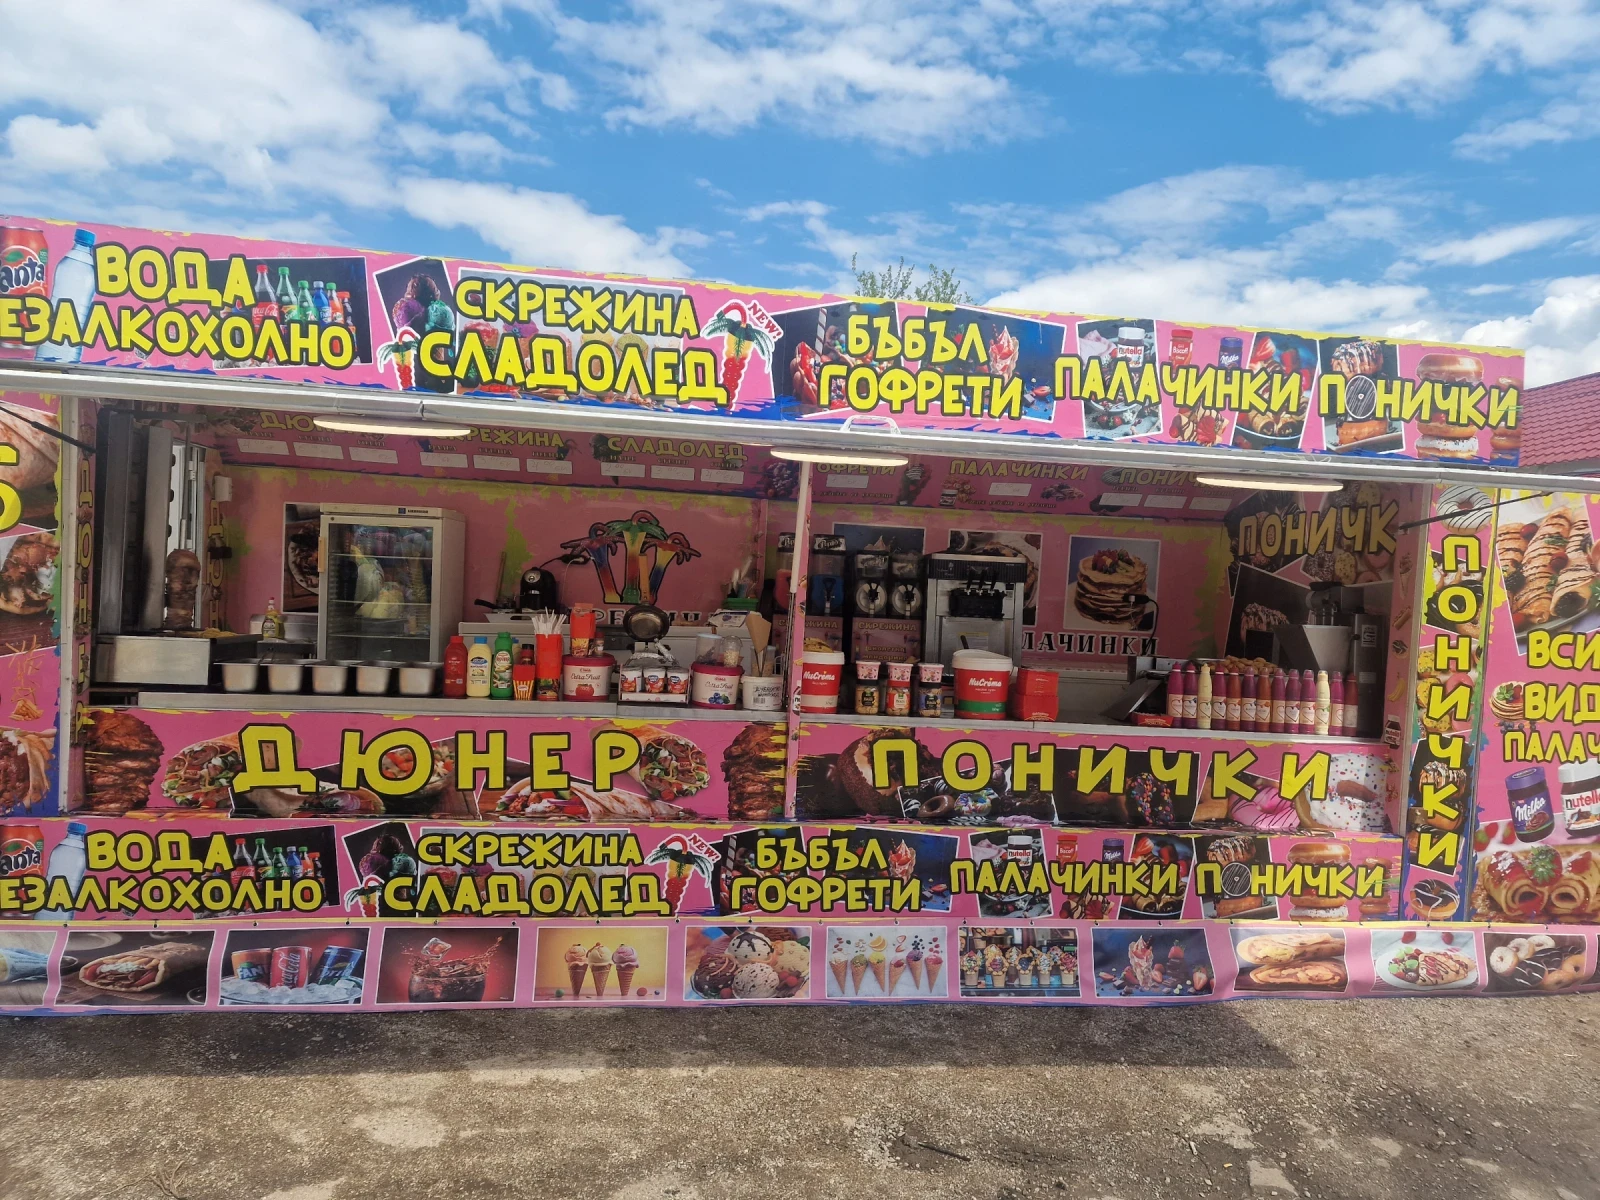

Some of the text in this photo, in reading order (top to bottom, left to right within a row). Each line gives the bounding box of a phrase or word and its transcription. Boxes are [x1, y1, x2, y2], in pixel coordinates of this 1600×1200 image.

[95, 242, 256, 308] ВОДА
[454, 276, 700, 338] СКРЕЖИНА
[748, 302, 782, 339] NEW!
[847, 312, 989, 364] БЪБЪЛ
[418, 330, 731, 407] СЛАДОЛЕД
[1053, 354, 1302, 415] ПАЛАЧИНКИ
[818, 363, 1023, 419] ГОФРЕТИ
[606, 435, 748, 461] СЛАДОЛЕД
[949, 459, 1090, 481] ПАЛАЧИНКИ
[1416, 534, 1482, 870] ПОНИЧКИ
[231, 723, 642, 797] ДЮНЕР
[871, 737, 1331, 801] ПОНИЧКИ
[1514, 797, 1547, 822] Milka
[1565, 789, 1600, 810] nutell
[85, 830, 234, 874] ВОДА
[416, 831, 645, 867] СКРЕЖИНА
[688, 833, 721, 862] NEW!
[755, 834, 888, 872] БЪБЪЛ
[382, 873, 673, 918] СЛАДОЛЕД
[730, 876, 923, 913] ГОФРЕТИ
[950, 858, 1178, 898] ПАЛАЧИНКИ
